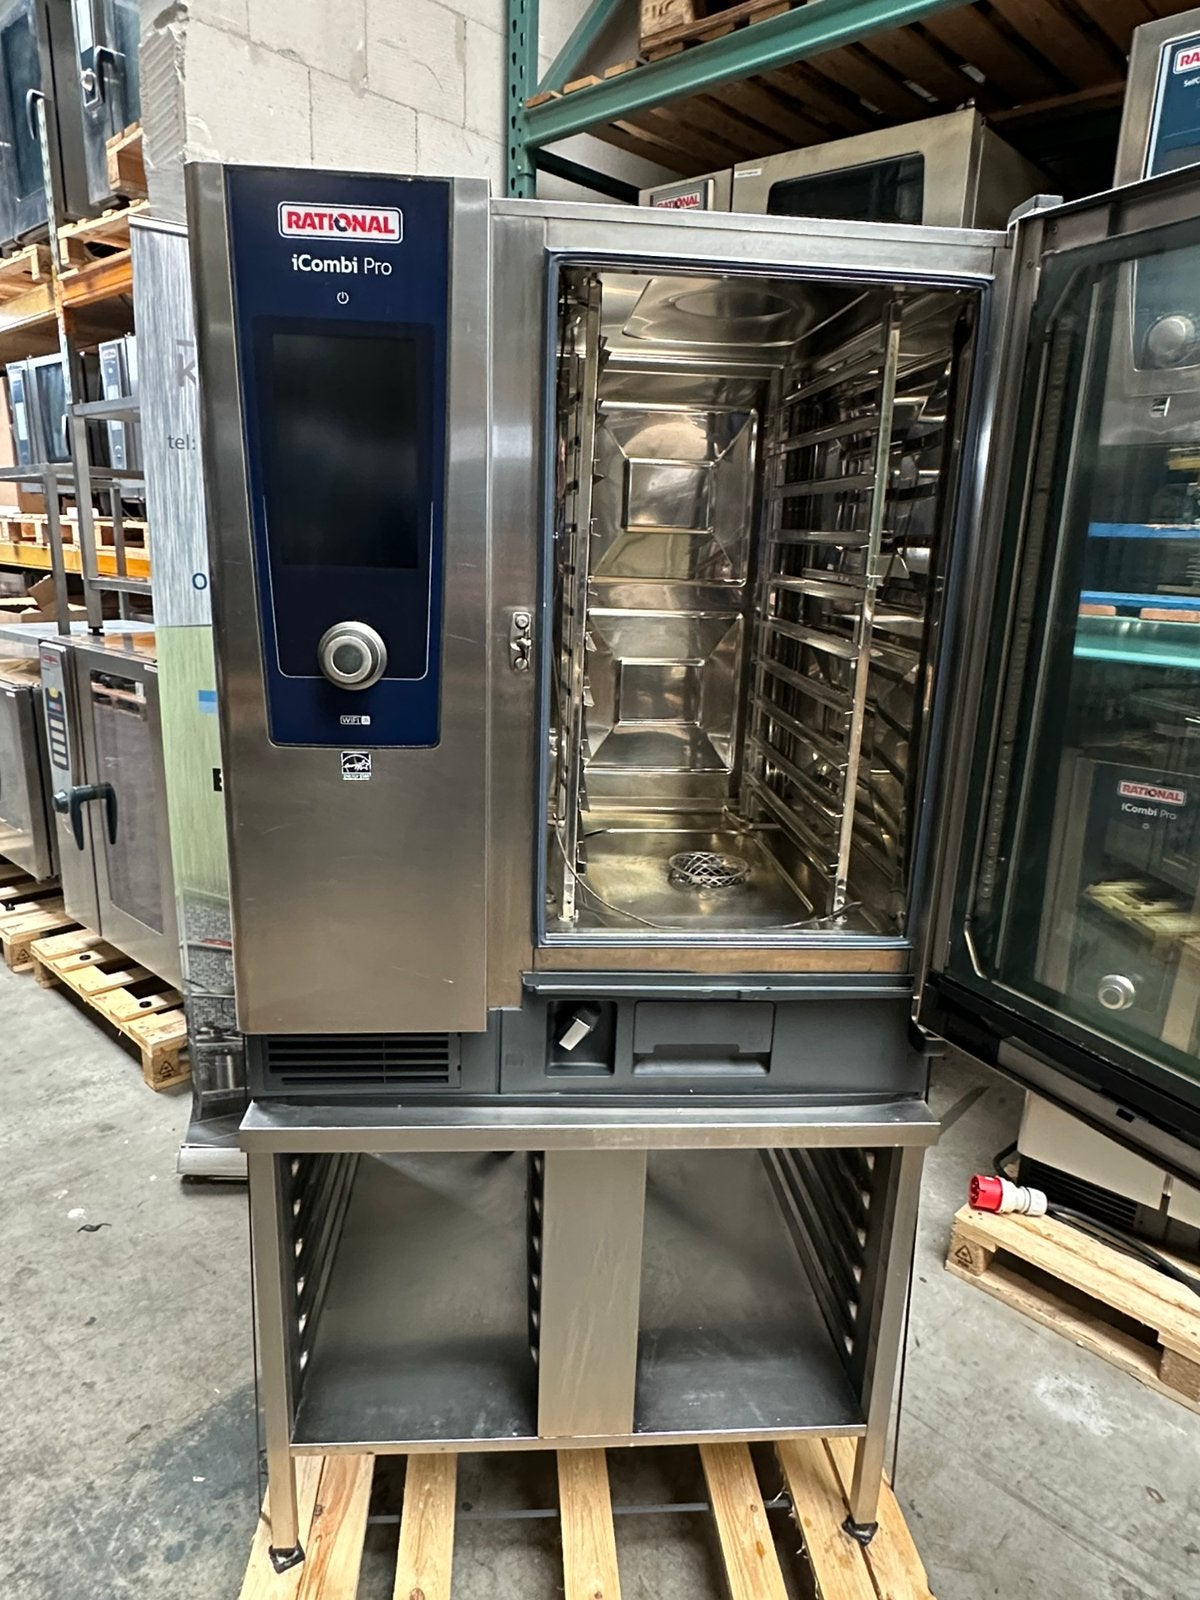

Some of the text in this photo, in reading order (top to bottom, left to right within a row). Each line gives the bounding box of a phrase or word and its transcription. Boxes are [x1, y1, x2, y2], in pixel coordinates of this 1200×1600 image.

[286, 211, 396, 234] RATIONAL
[291, 253, 393, 276] iCombi Pro
[167, 433, 196, 451] tel:
[1122, 783, 1183, 802] RATIONAL
[1121, 802, 1178, 821] iCombi Pro
